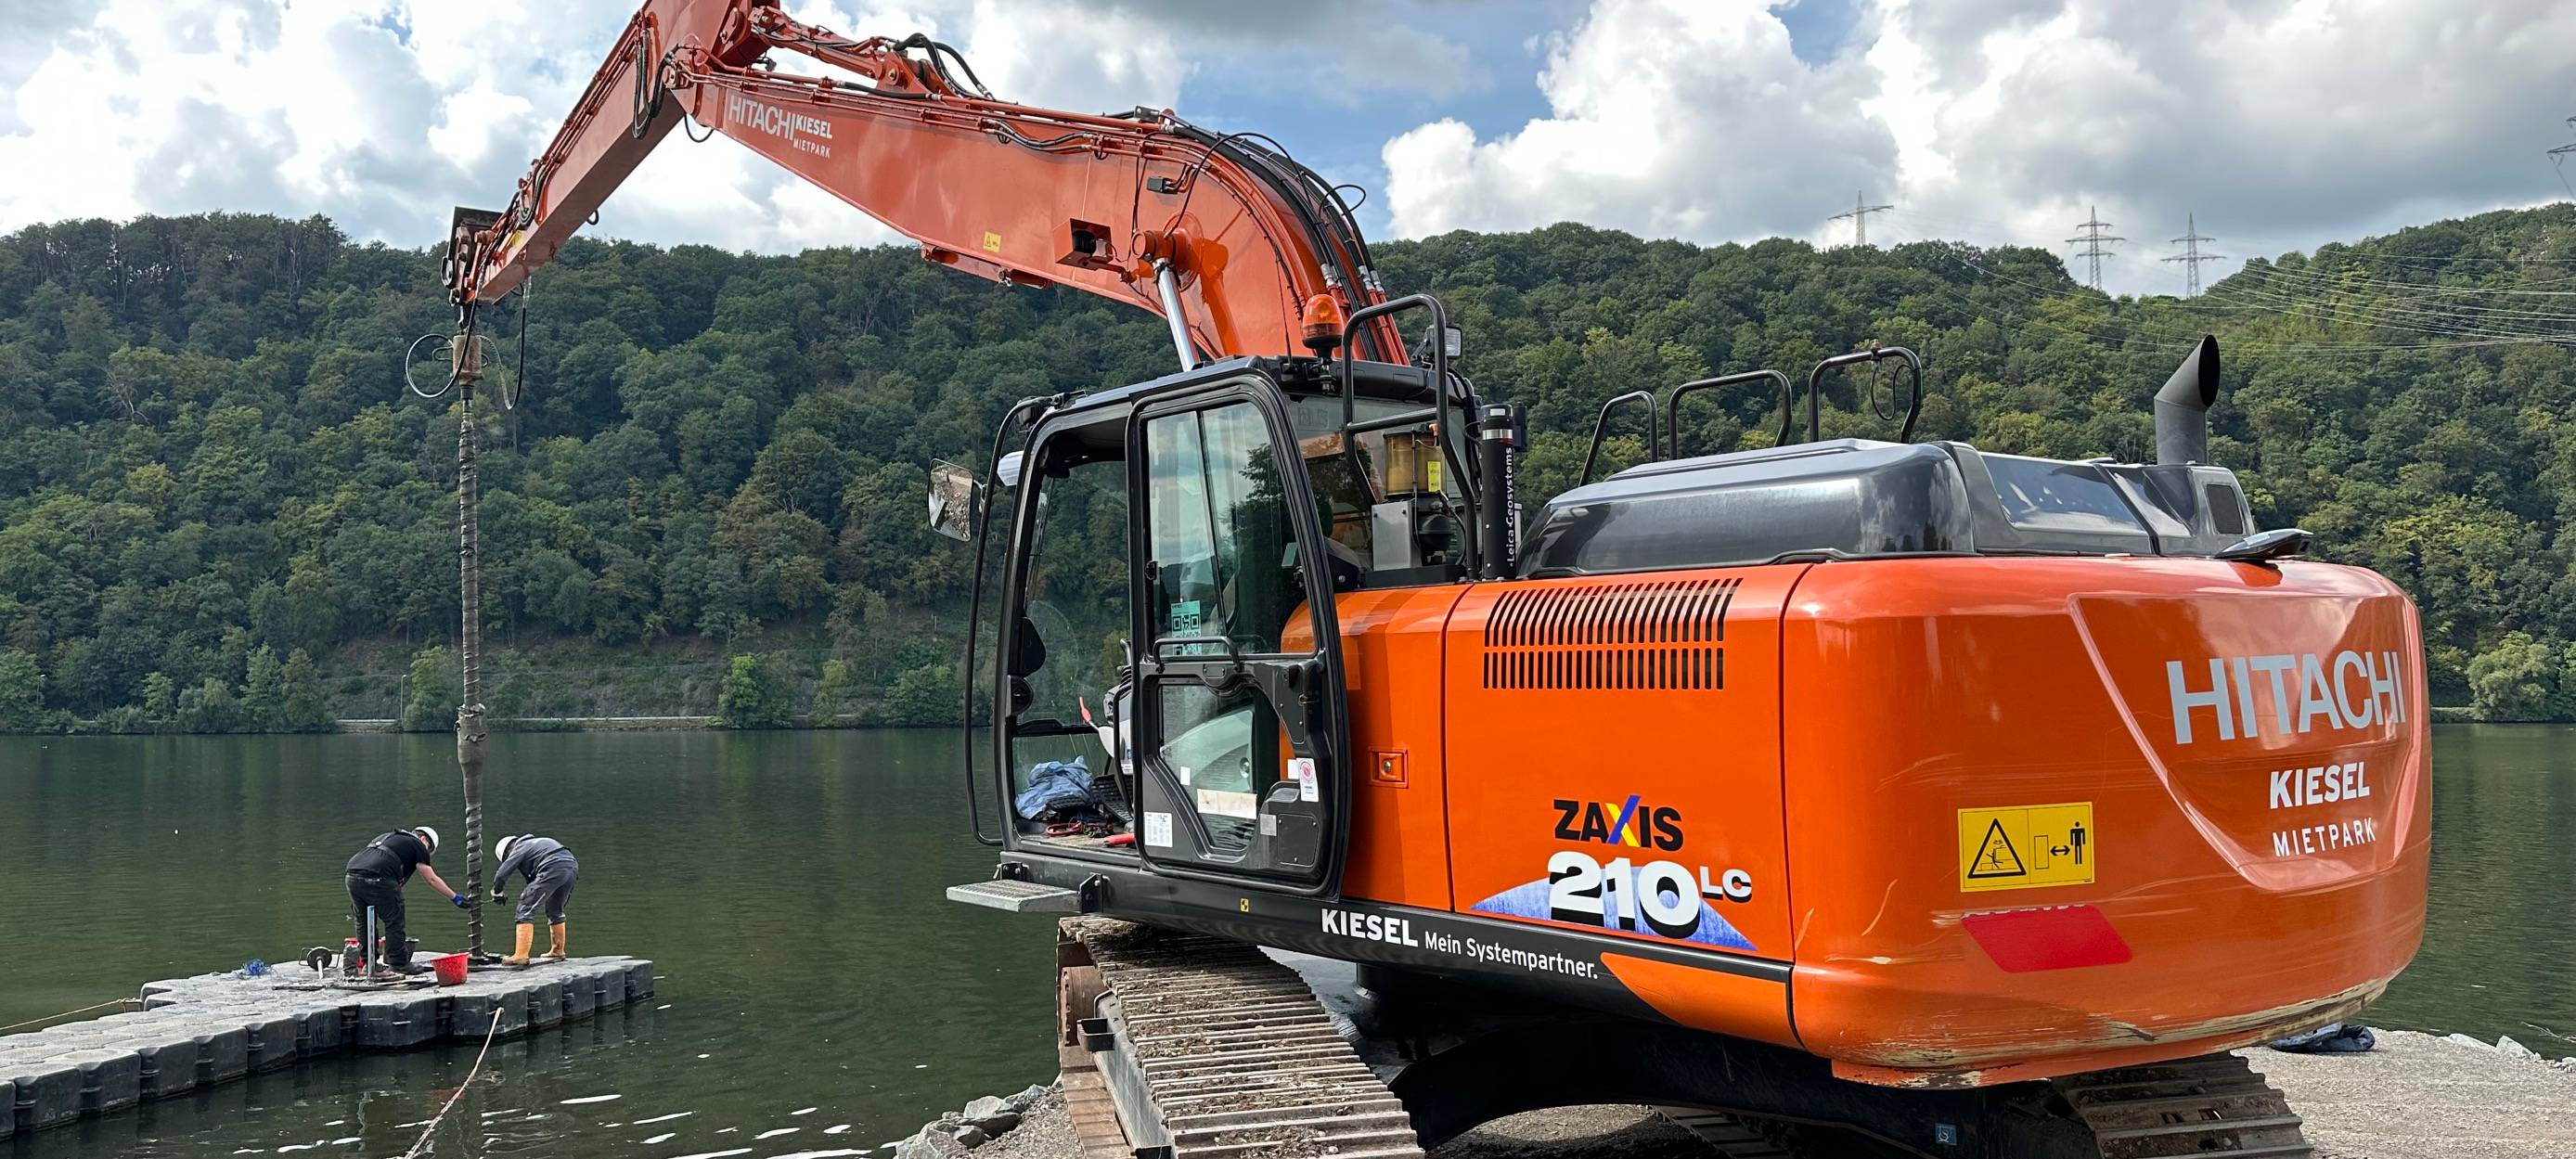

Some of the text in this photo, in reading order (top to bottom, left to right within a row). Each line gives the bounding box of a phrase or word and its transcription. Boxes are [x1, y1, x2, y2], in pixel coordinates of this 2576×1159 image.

[728, 95, 833, 141] HITACHI KIESEL
[792, 138, 831, 159] MIETPARK
[1504, 446, 1515, 562] Leica Geosystems
[2166, 650, 2406, 745] HITACHI
[2270, 761, 2371, 810] KIESEL
[1553, 794, 1685, 852] ZAXIS
[2272, 817, 2376, 857] MIETPARK
[1320, 908, 1599, 980] KIESEL Mein Systempartner.
